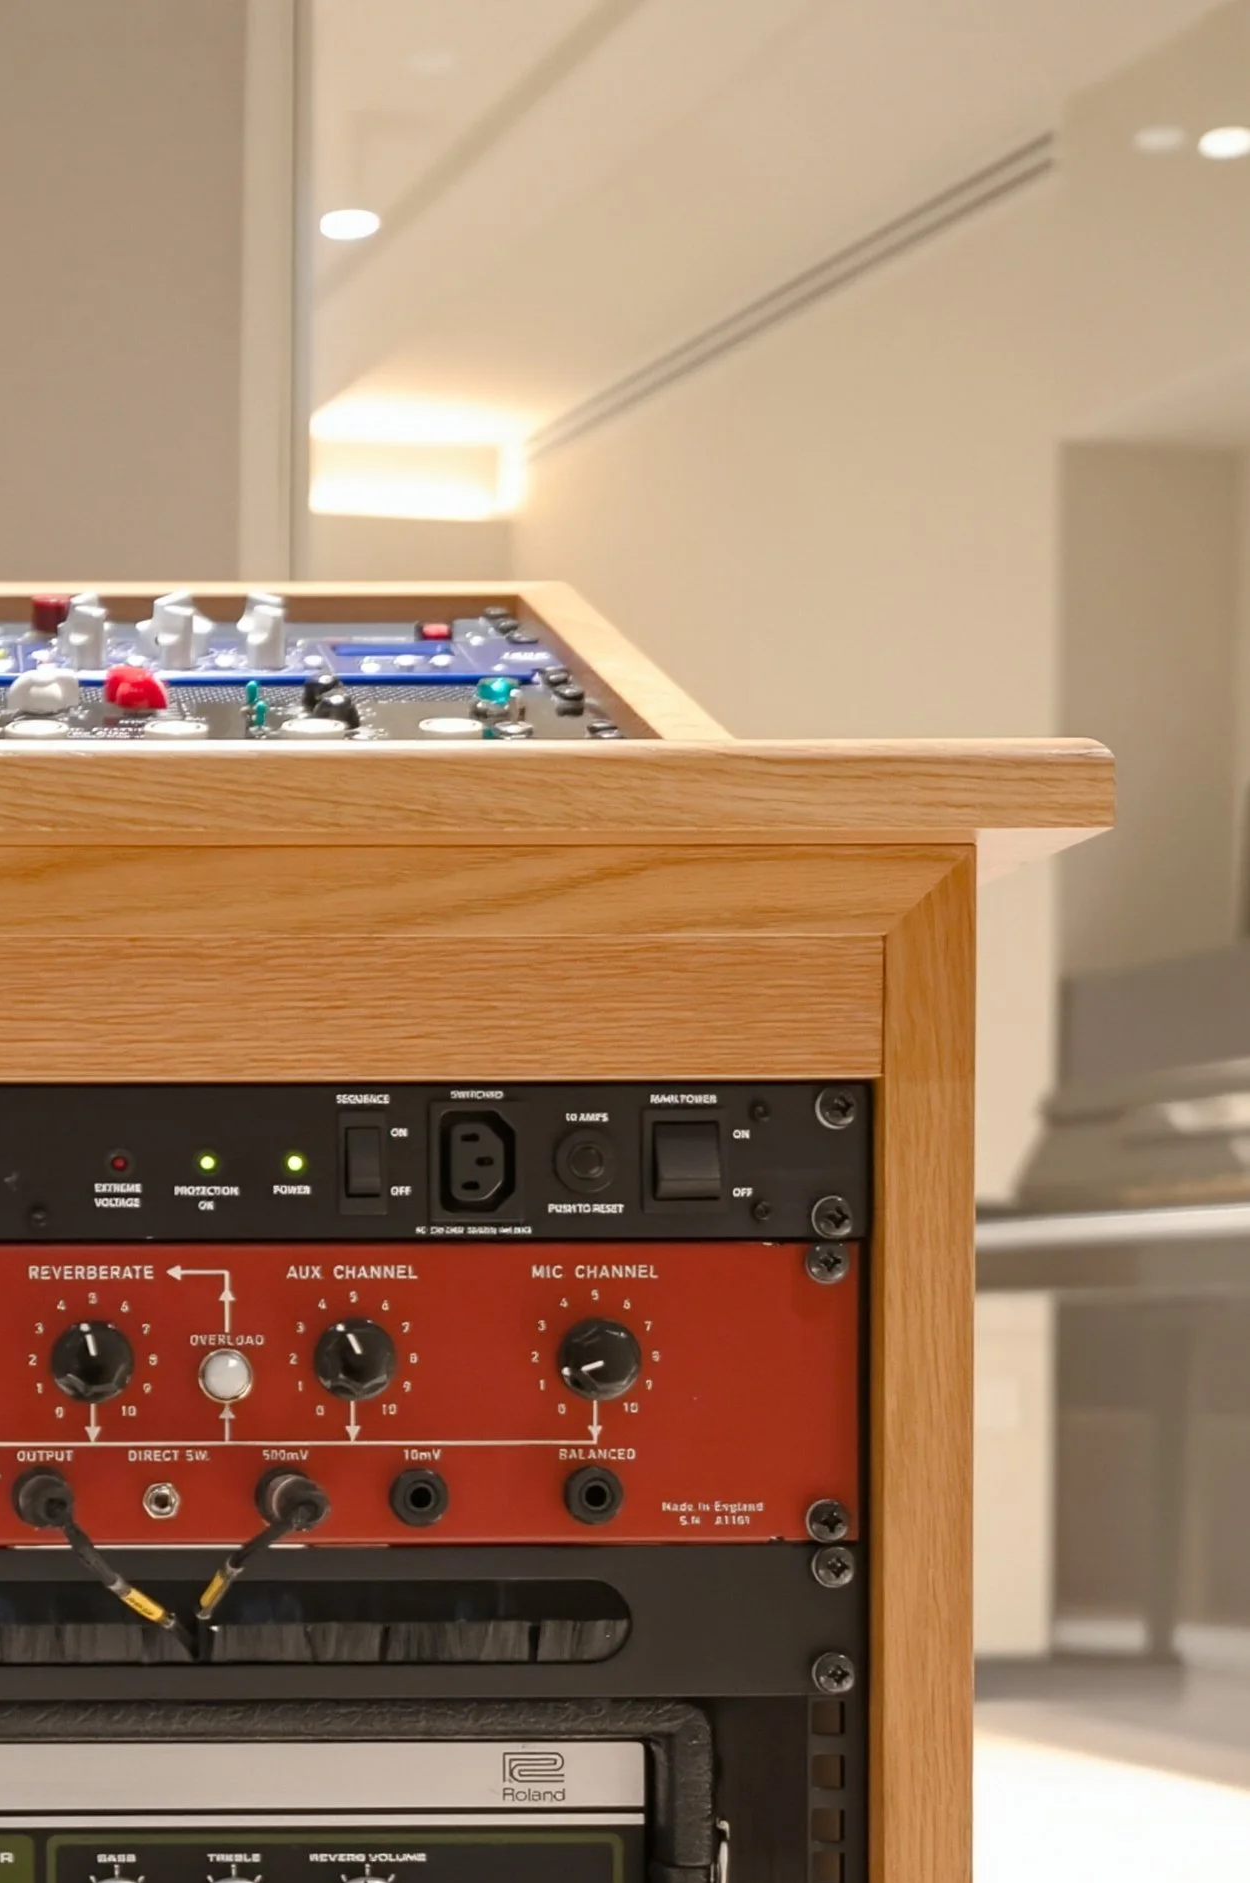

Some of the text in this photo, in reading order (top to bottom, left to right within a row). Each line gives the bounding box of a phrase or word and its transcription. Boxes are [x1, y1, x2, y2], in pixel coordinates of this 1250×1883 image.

[336, 1094, 390, 1104] SEQUENCE
[579, 1113, 609, 1122] AMPS
[390, 1128, 408, 1137] ON
[733, 1130, 750, 1139] ON
[94, 1183, 142, 1194] EXTREME
[174, 1185, 240, 1197] PROTECTION
[273, 1184, 311, 1195] POWER
[390, 1186, 412, 1196] OFF
[733, 1188, 753, 1197] OFF
[94, 1197, 141, 1208] VOLTAGE
[592, 1203, 625, 1213] RESET
[28, 1265, 154, 1280] REVERBERATE
[286, 1265, 418, 1280] AUX CHANNEL
[531, 1265, 659, 1279] MIC CHANNEL
[350, 1291, 358, 1303] 5
[644, 1320, 653, 1331] 7
[189, 1334, 265, 1346] OVERLOAD
[29, 1354, 37, 1366] 2
[289, 1353, 298, 1364] 2
[531, 1351, 539, 1362] 2
[539, 1379, 545, 1390] 1
[122, 1405, 136, 1417] 10
[382, 1404, 397, 1415] 10
[16, 1450, 74, 1461] OUTPUT
[128, 1450, 179, 1461] DIRECT
[261, 1449, 309, 1461] 500mV
[403, 1449, 442, 1460] 10mV
[558, 1448, 636, 1461] BALANCED
[661, 1501, 695, 1512] Made
[713, 1501, 764, 1515] England
[503, 1787, 566, 1802] Roland
[97, 1853, 136, 1863] BASS
[207, 1853, 261, 1863] TREBLE
[309, 1852, 427, 1863] REVERB VOLUME
